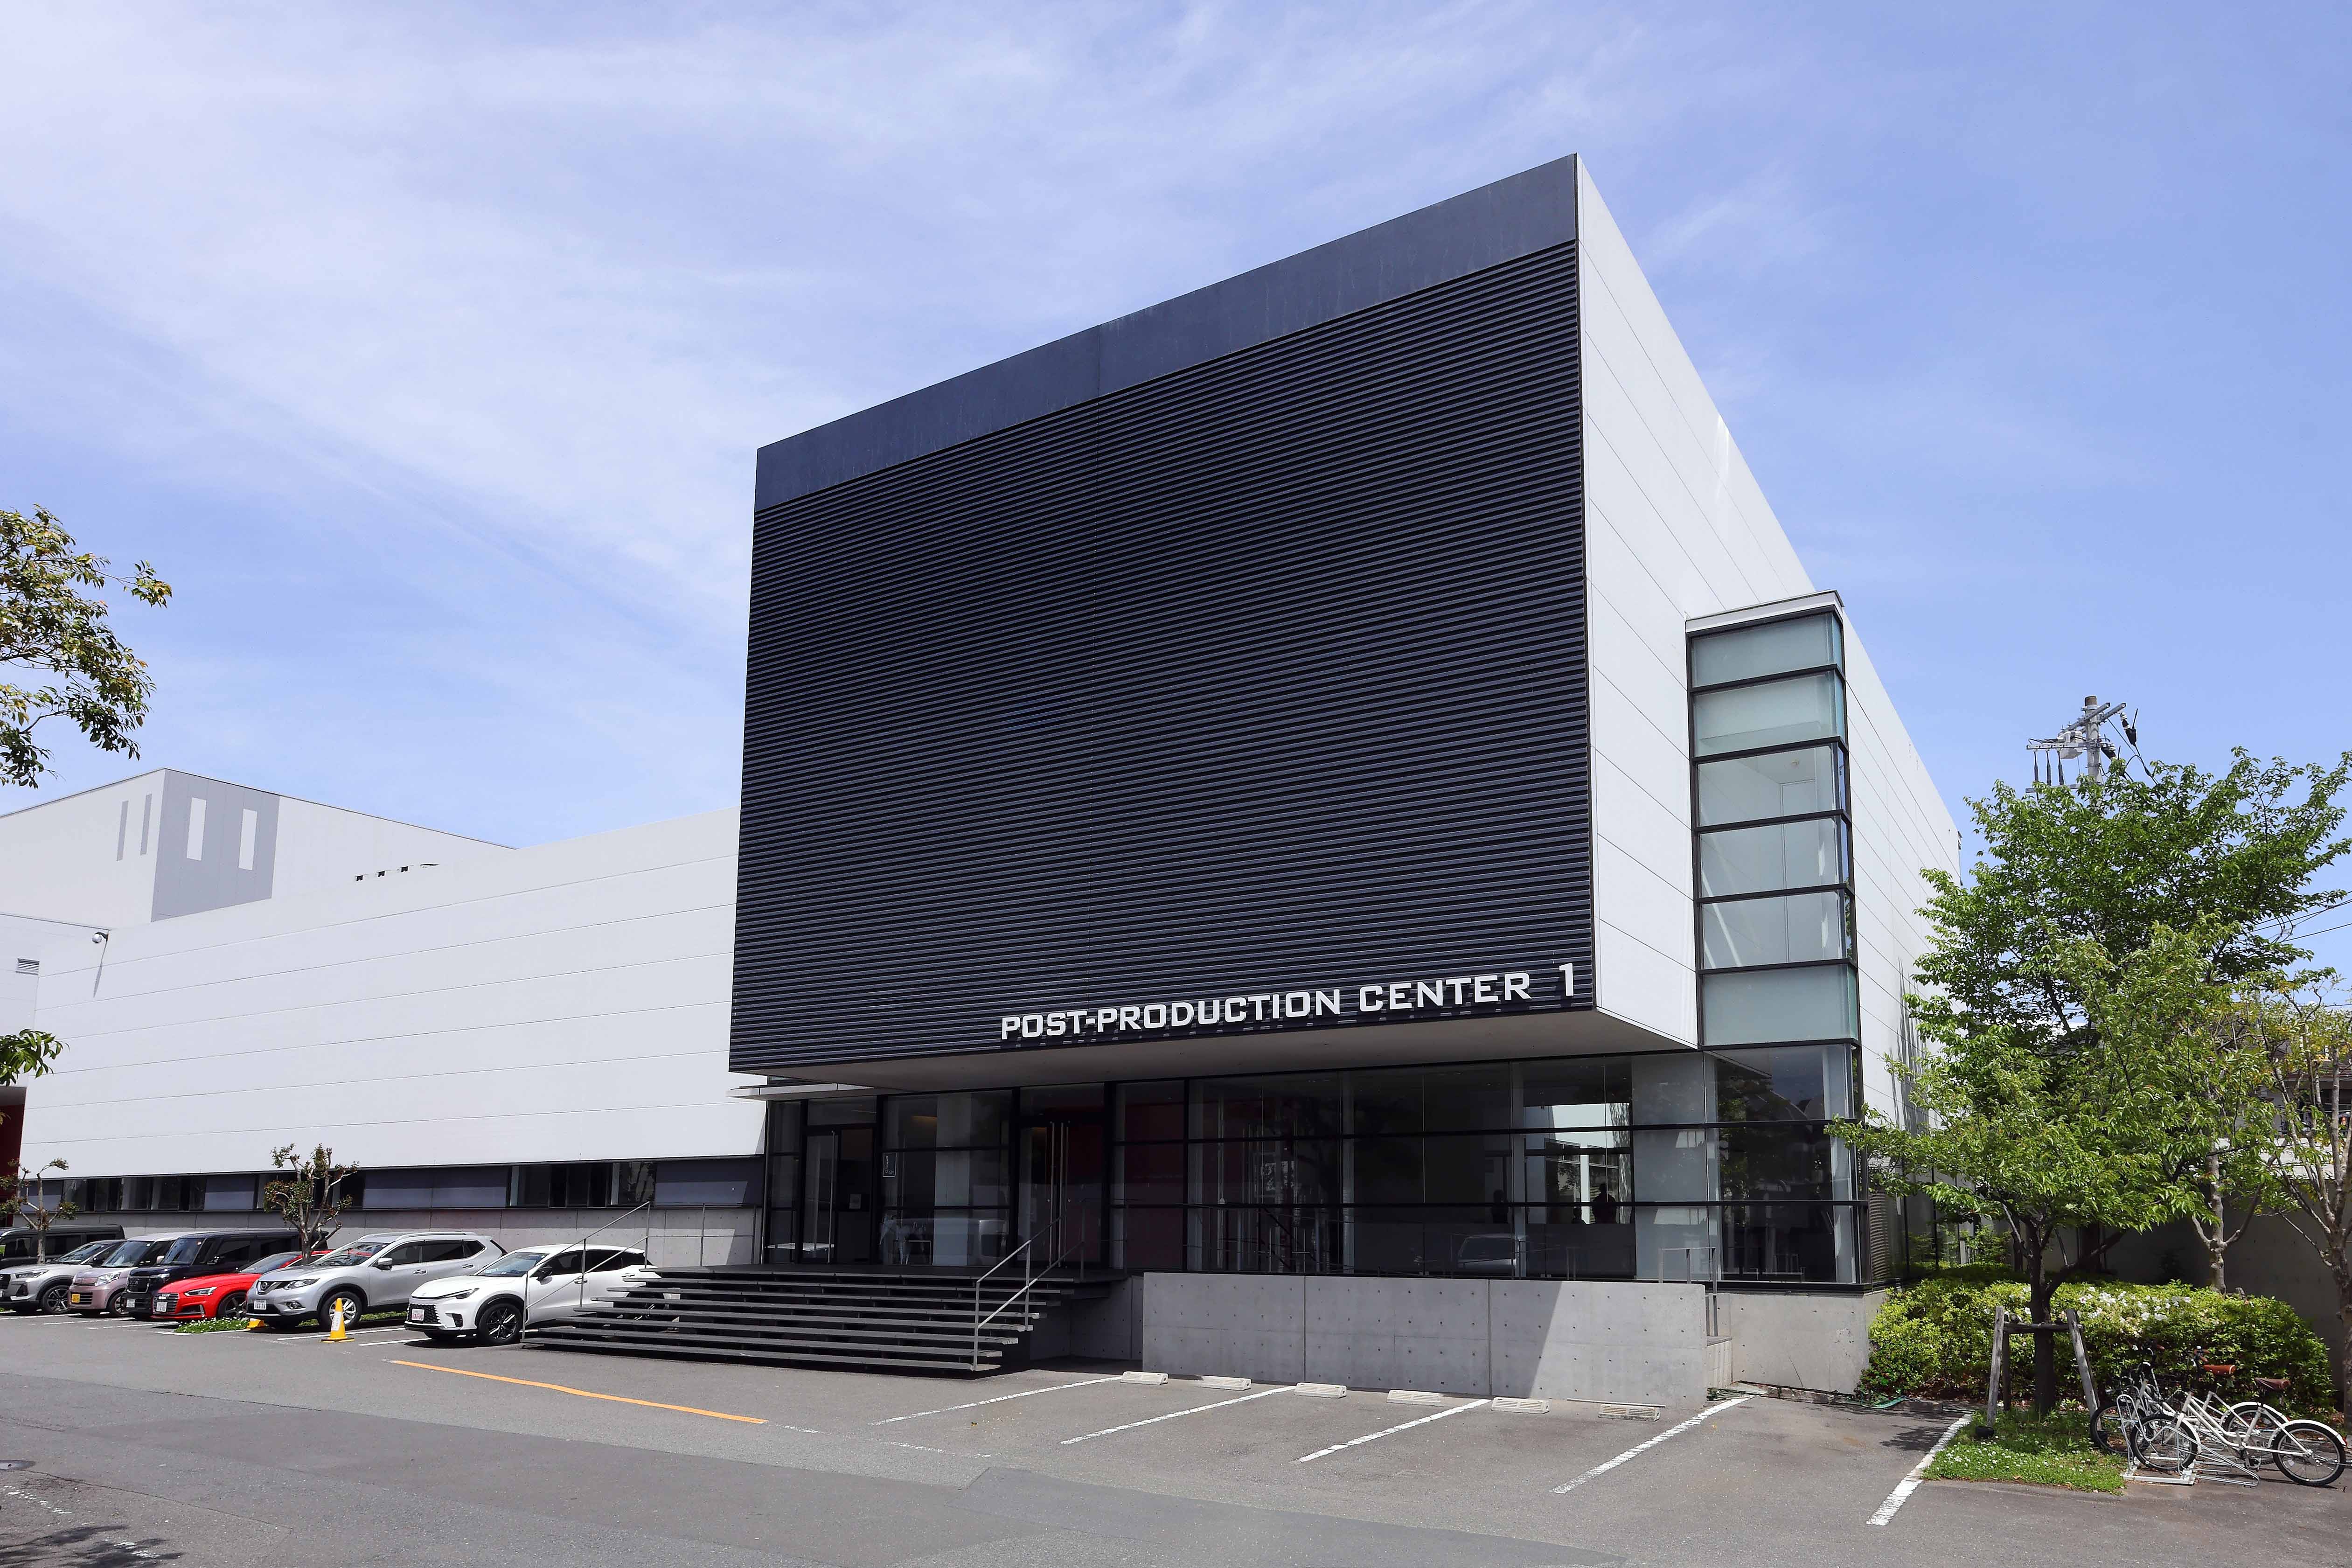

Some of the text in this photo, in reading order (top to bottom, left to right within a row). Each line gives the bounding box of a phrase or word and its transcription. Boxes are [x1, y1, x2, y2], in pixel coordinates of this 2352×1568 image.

[1001, 962, 1574, 1040] POST-PRODUCTION CENTER 1
